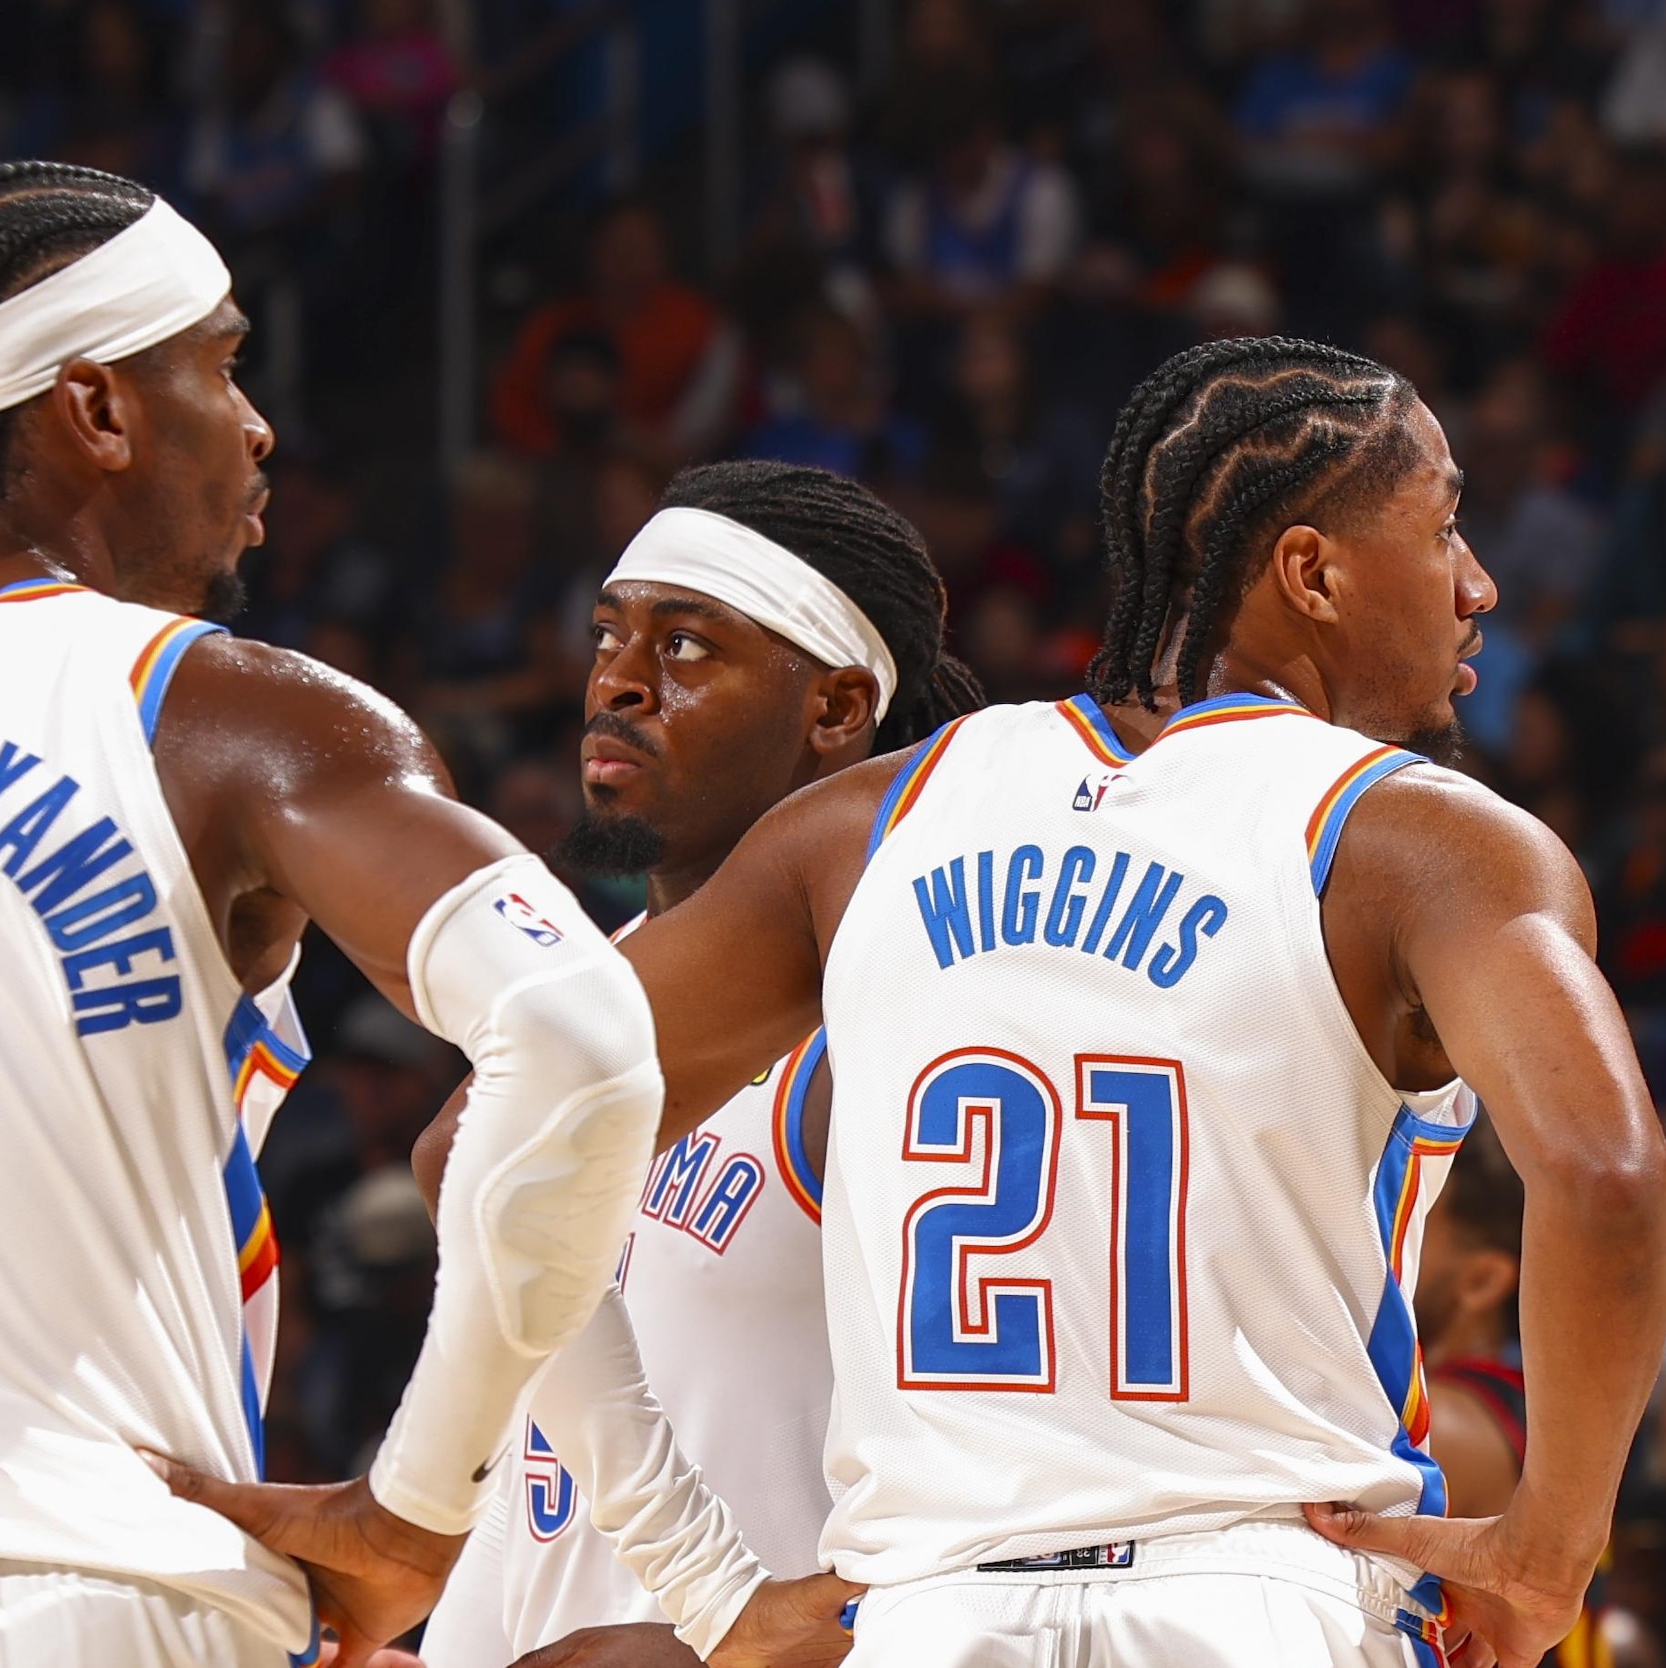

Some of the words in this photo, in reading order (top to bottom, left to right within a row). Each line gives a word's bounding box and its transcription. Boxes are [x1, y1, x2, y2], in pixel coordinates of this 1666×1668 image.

[912, 844, 1228, 989] WIGGINS
[639, 1130, 766, 1257] MA
[897, 1046, 1190, 1403] 21
